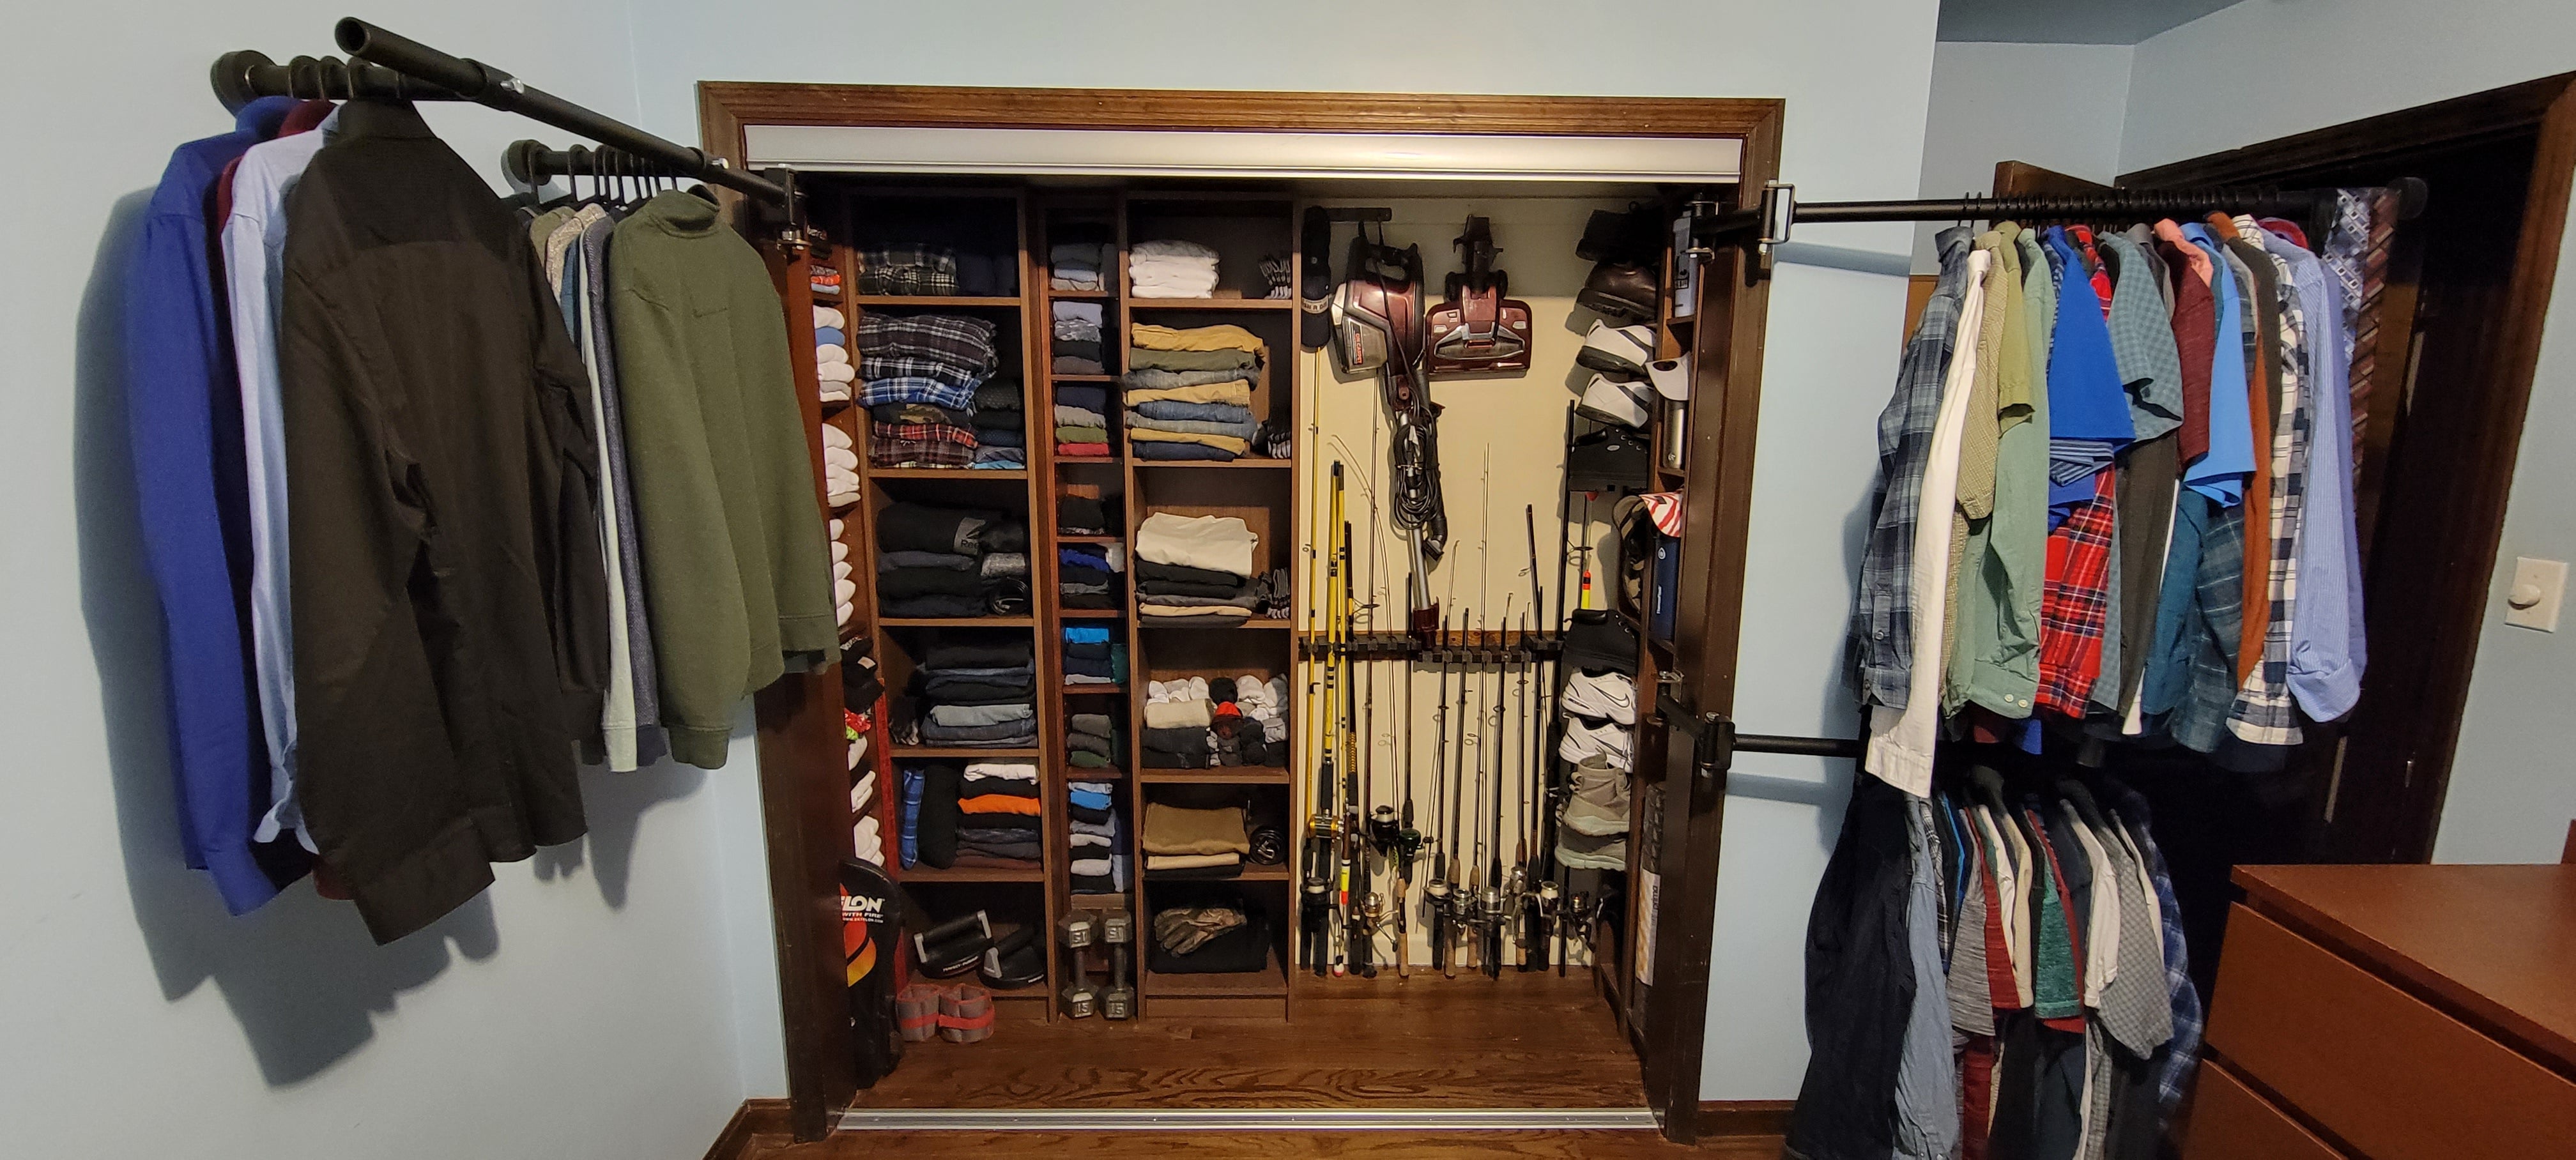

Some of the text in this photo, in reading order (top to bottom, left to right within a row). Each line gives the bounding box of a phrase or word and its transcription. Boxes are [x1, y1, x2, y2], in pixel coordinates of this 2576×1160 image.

[1355, 333, 1360, 342] ON
[1073, 931, 1085, 943] 15
[1109, 926, 1123, 940] 15
[1078, 1003, 1088, 1013] 15
[1112, 1003, 1124, 1014] 15
